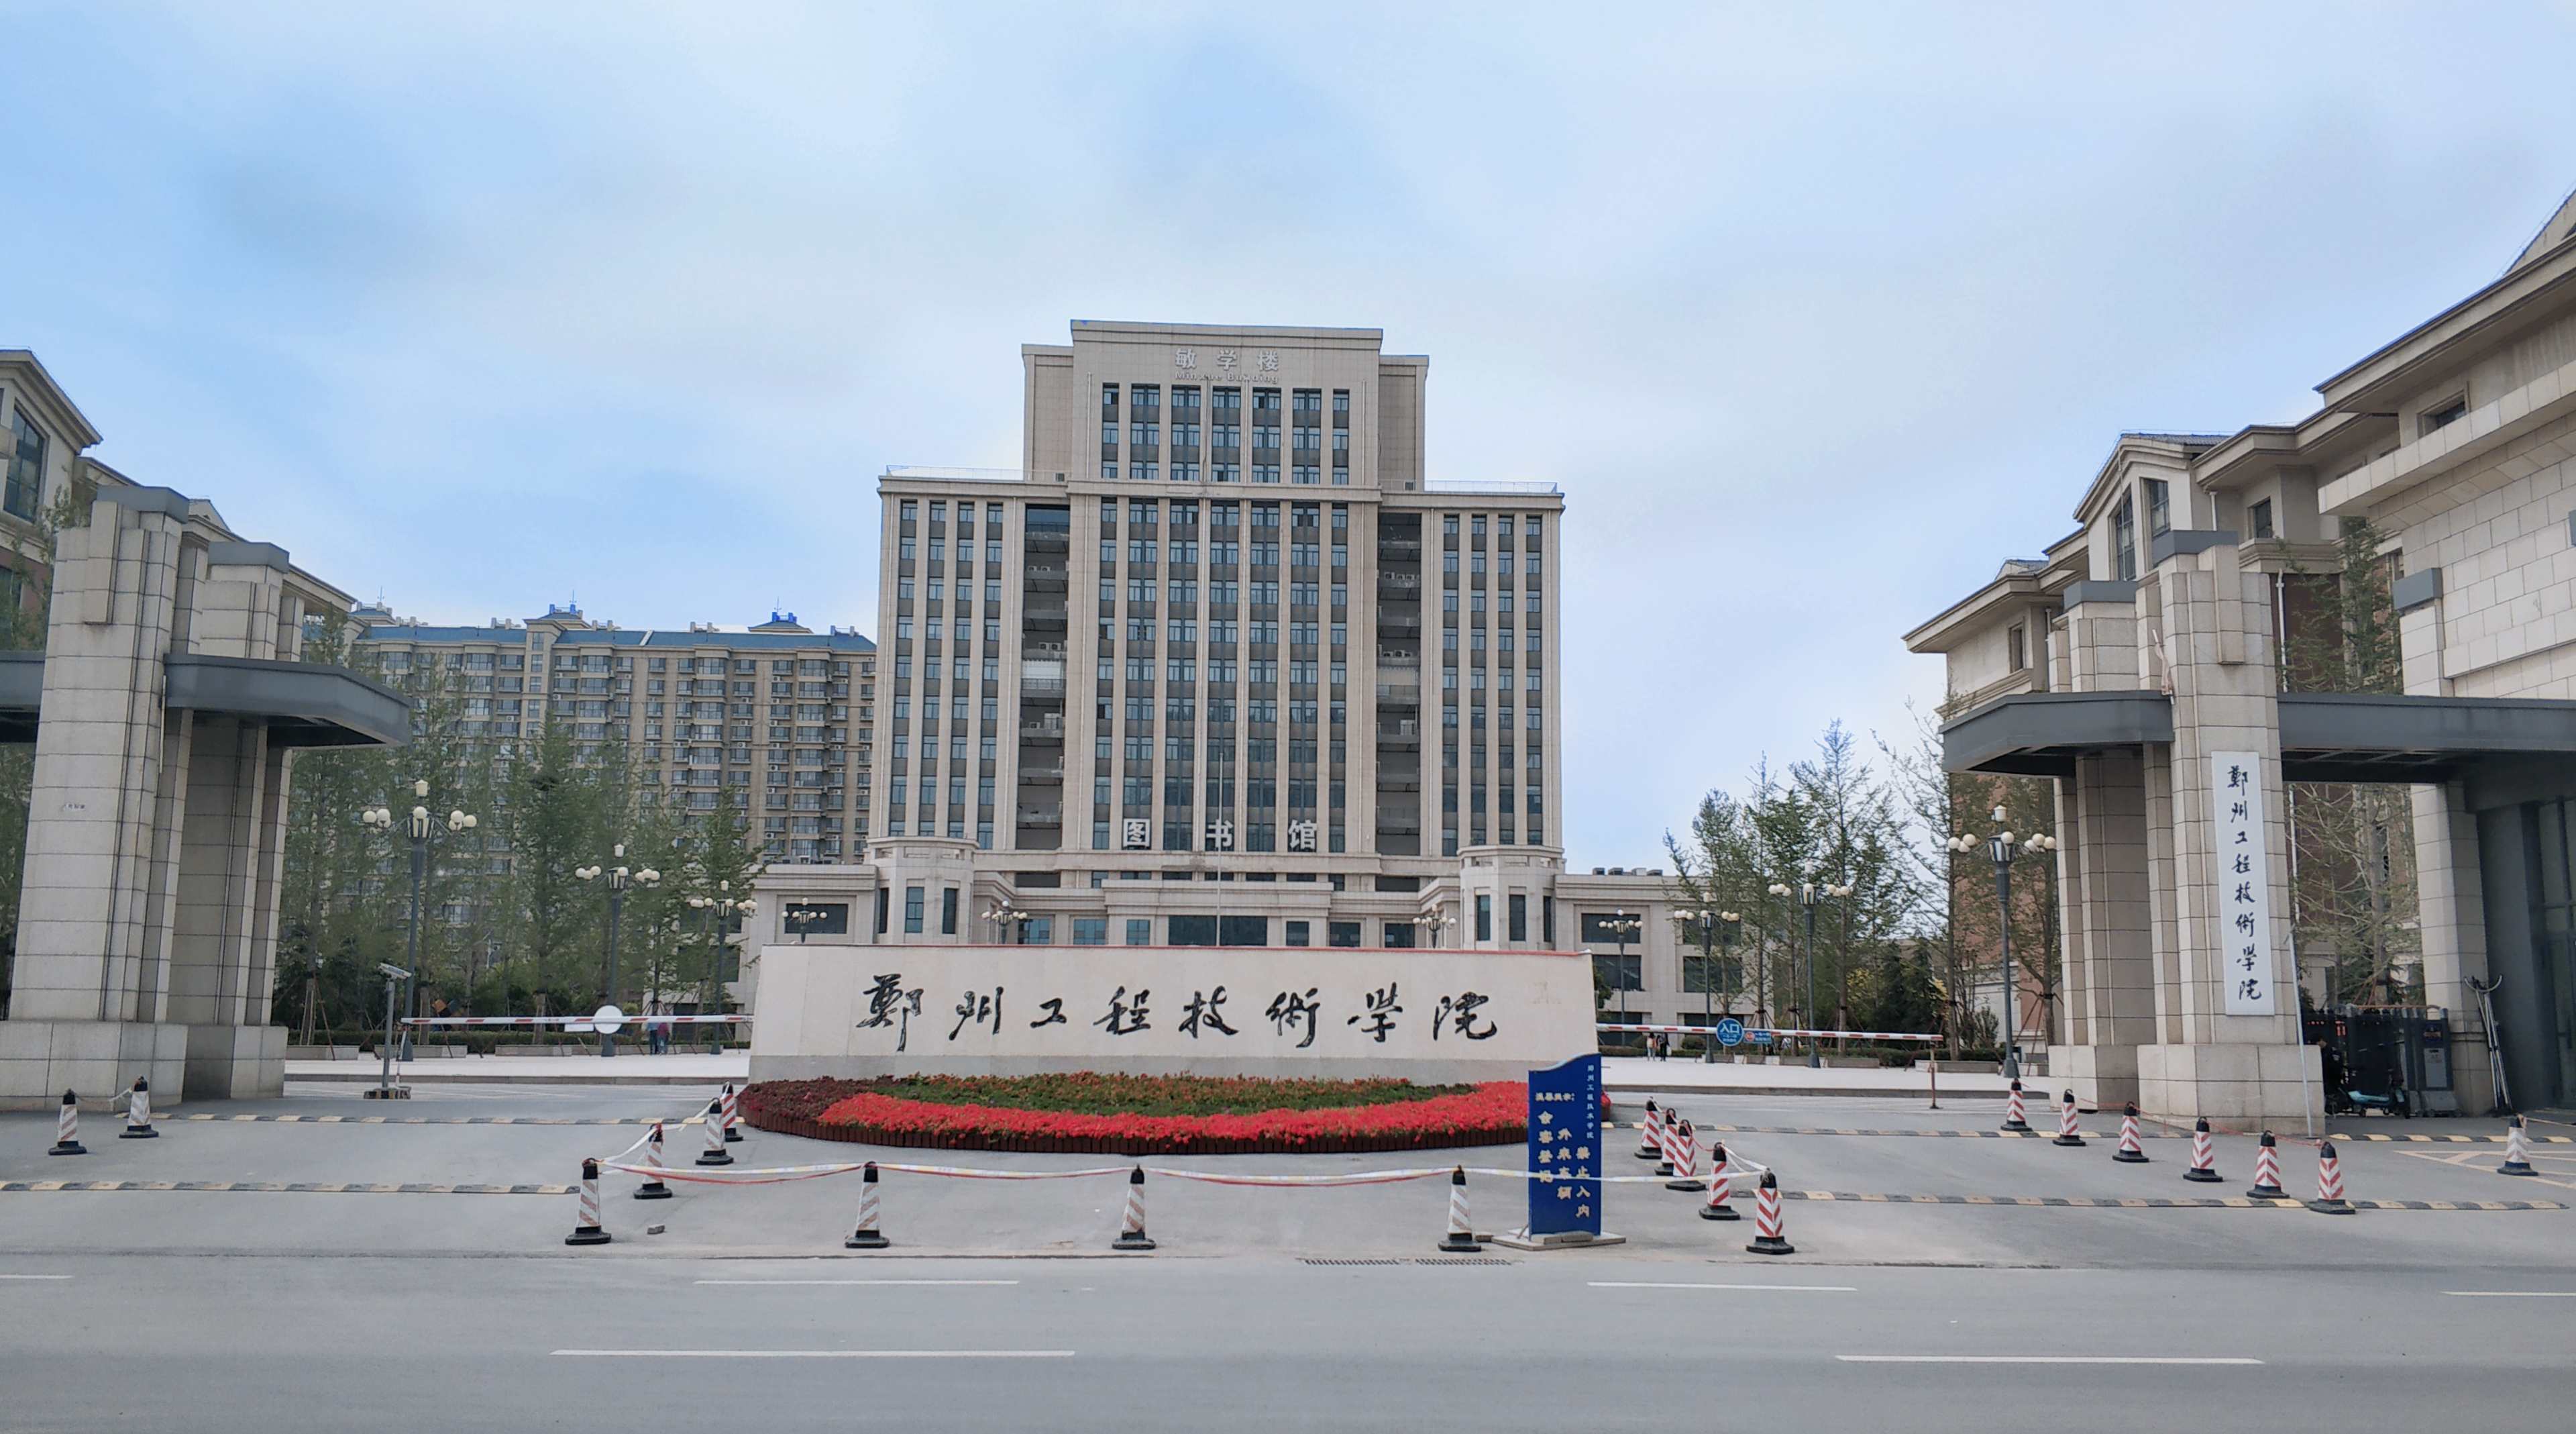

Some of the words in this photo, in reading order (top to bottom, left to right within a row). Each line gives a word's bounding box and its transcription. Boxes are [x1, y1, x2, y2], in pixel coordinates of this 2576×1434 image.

[1175, 348, 1279, 371] 敏学楼
[1175, 371, 1222, 381] Minxue
[1227, 372, 1279, 383] Building
[1123, 818, 1318, 850] 图书馆
[1719, 1023, 1739, 1033] 入口
[1557, 1129, 1572, 1200] 外来车辆
[1576, 1146, 1591, 1217] 禁止入内
